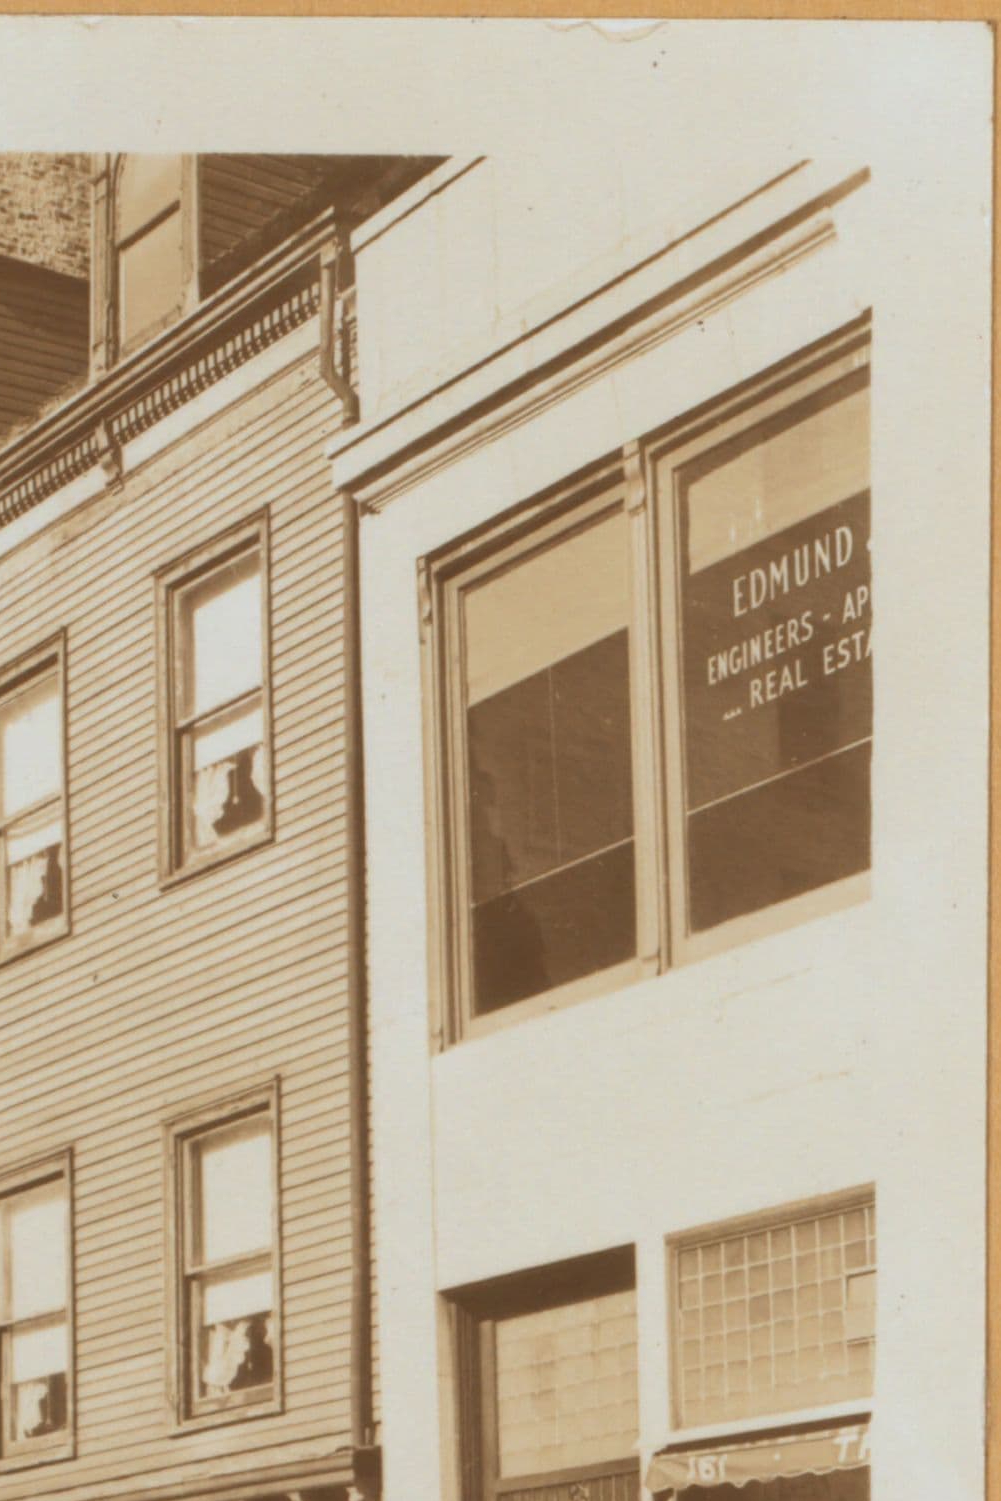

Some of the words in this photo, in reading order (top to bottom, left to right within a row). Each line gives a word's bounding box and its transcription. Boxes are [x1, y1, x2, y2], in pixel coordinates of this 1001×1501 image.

[732, 526, 853, 617] EDMUND
[707, 610, 814, 685] ENGINEERS
[749, 659, 808, 708] REAL
[689, 1454, 727, 1483] 161
